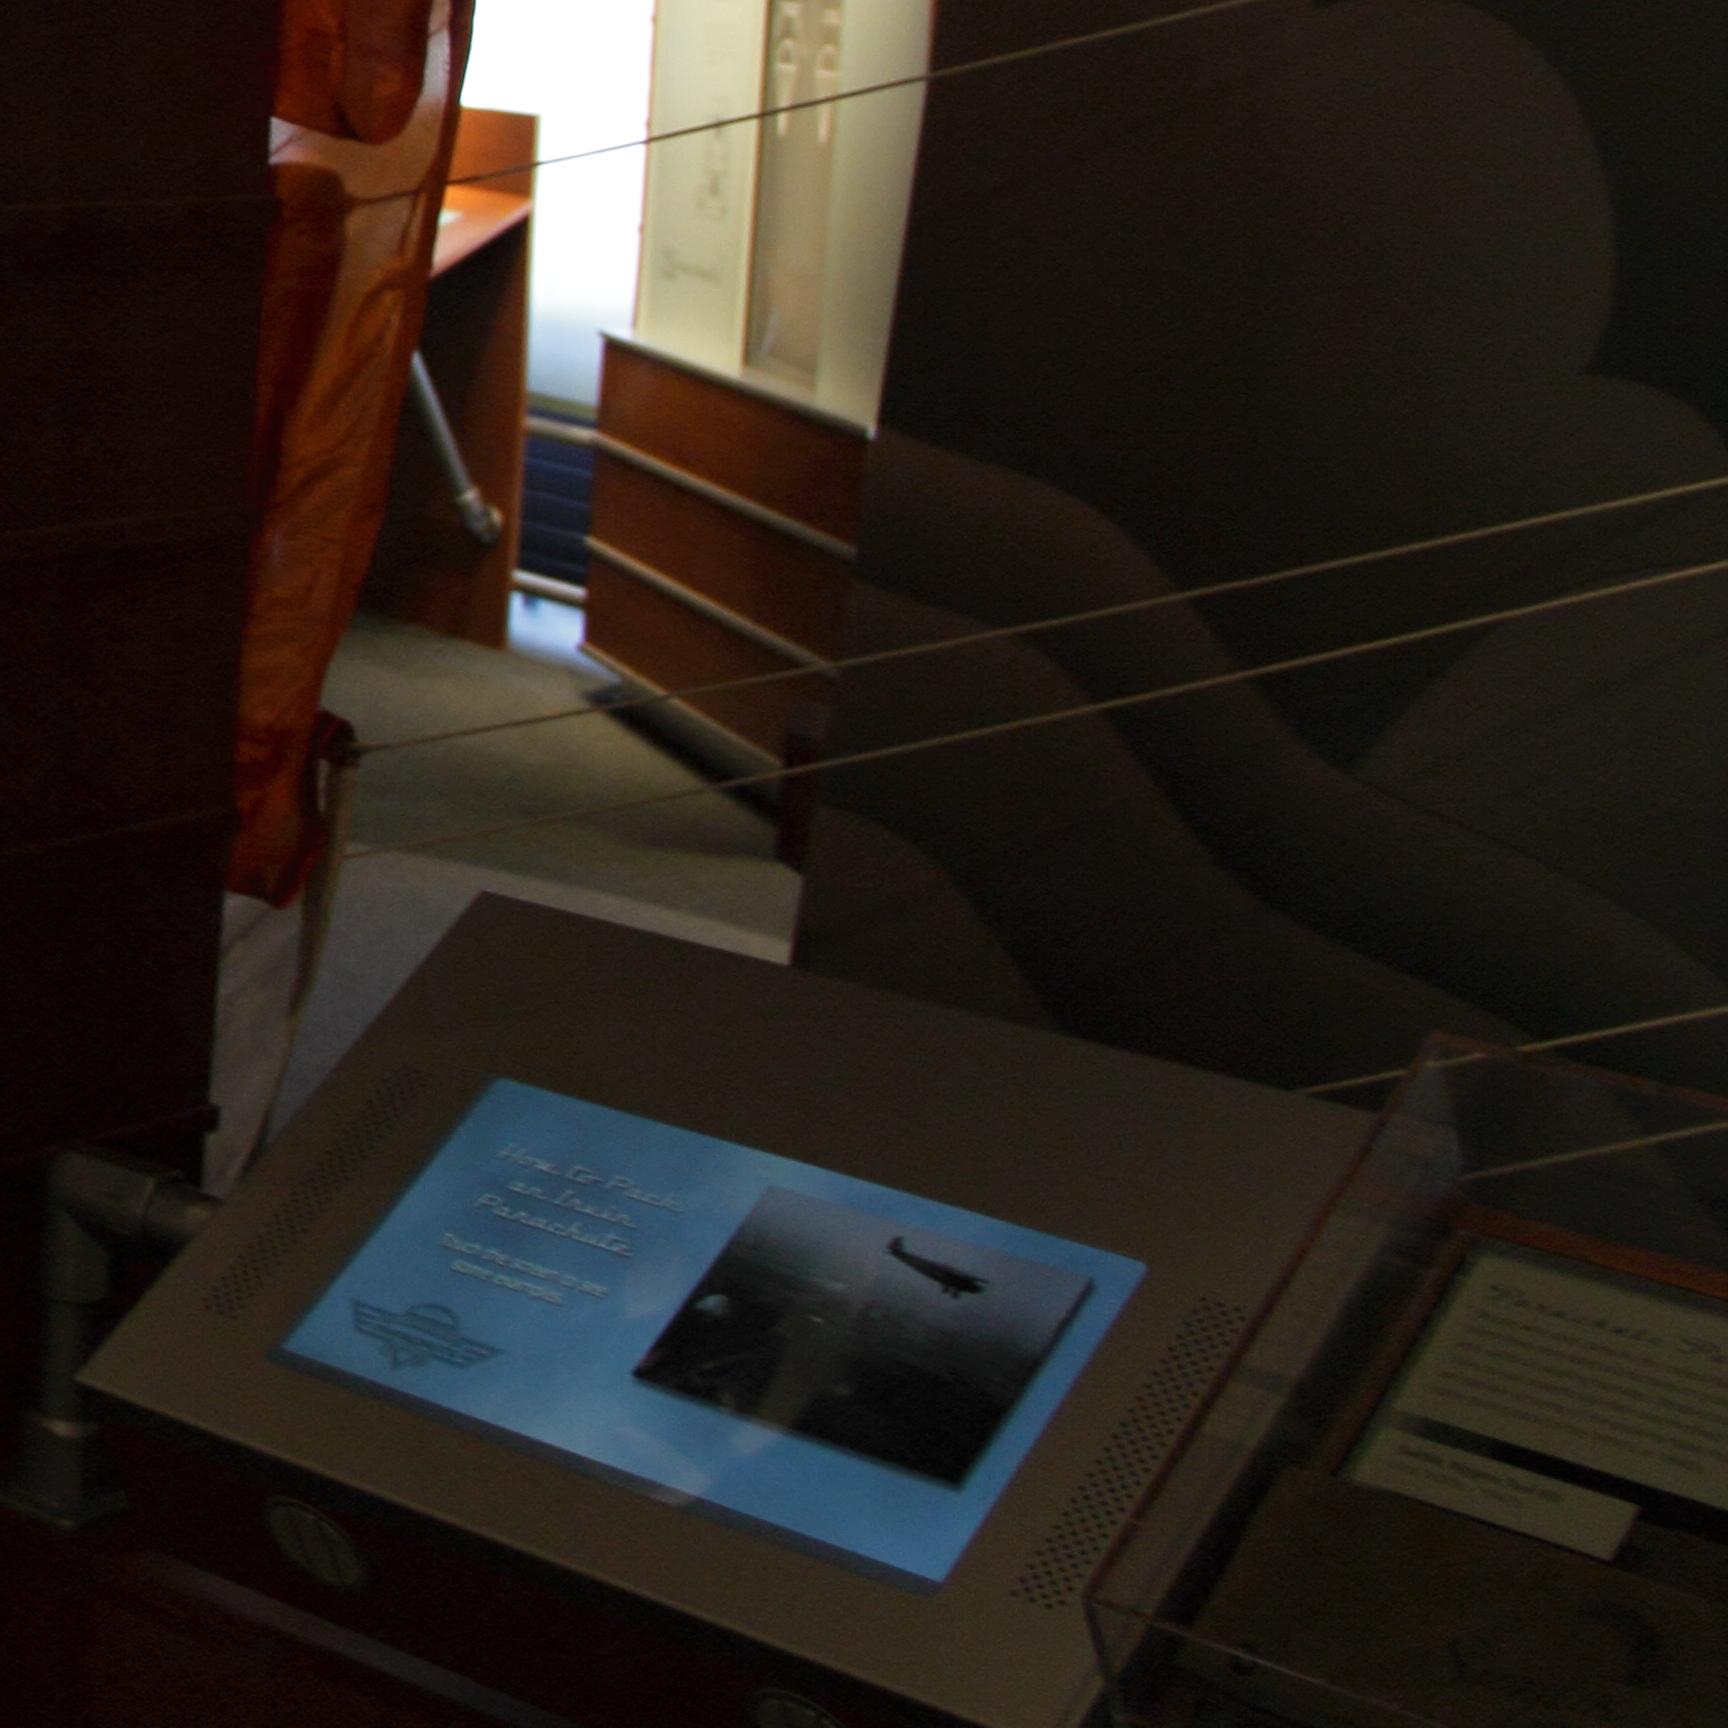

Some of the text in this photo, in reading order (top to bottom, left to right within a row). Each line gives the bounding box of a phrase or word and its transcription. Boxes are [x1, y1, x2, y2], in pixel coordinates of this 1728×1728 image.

[499, 1144, 563, 1176] How
[605, 1174, 684, 1212] Pack
[507, 1180, 552, 1201] an
[473, 1193, 635, 1257] Parachute
